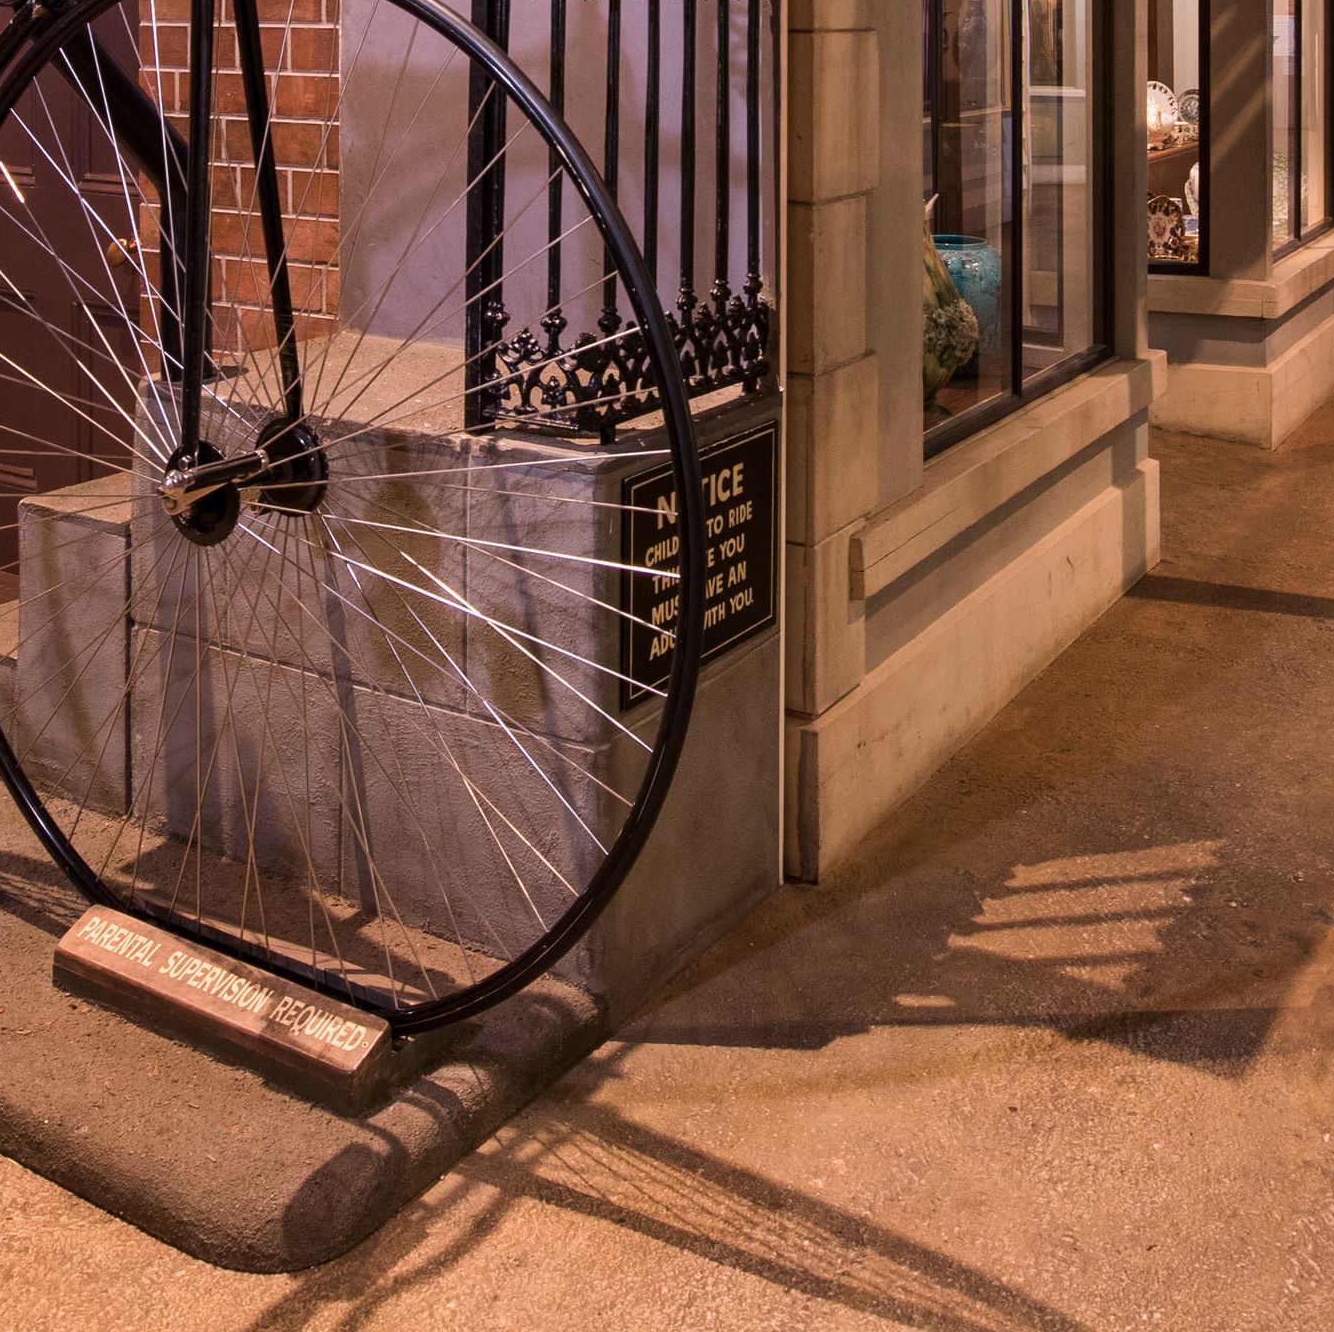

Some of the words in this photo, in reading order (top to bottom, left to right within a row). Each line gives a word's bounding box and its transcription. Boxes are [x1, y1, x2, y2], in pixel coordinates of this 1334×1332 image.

[657, 462, 744, 530] NICE
[645, 536, 680, 567] CHILD
[705, 514, 724, 538] TO
[728, 500, 753, 529] RIDE
[719, 533, 745, 561] YOU
[649, 626, 678, 662] ADU
[729, 587, 754, 615] YOU.
[652, 594, 680, 626] MUS
[727, 560, 747, 588] AN
[77, 915, 162, 968] PARENTAL
[158, 949, 275, 1015] SUPERVISION
[269, 995, 367, 1052] REQUIRED
